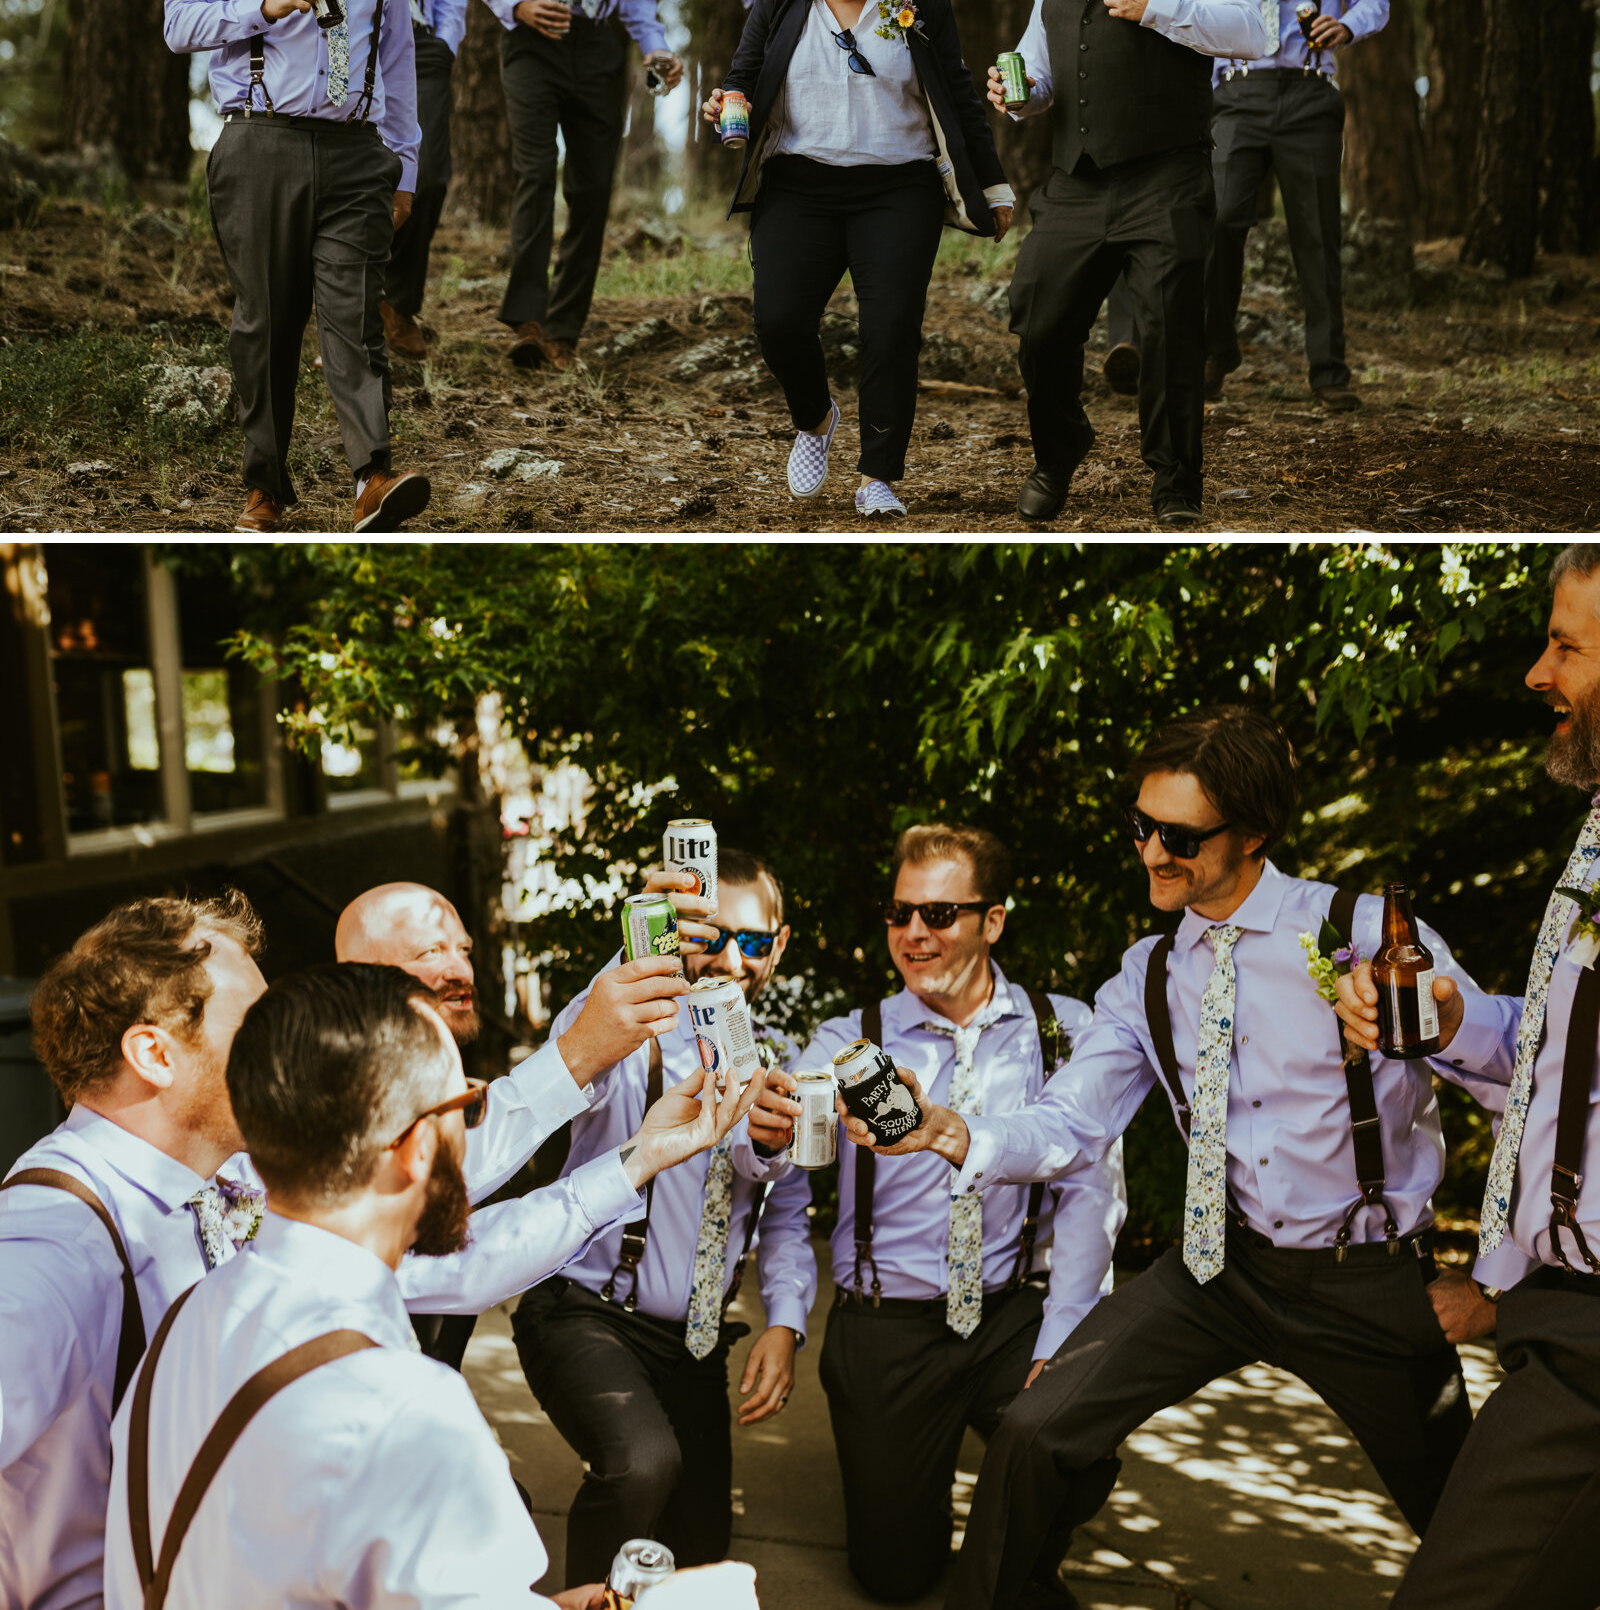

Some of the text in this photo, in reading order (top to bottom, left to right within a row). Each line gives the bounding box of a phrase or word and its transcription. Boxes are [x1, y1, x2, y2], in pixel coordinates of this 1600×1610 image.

[669, 836, 710, 865] Lite
[861, 1069, 896, 1107] PARTY ON
[885, 1119, 917, 1137] FRIEND
